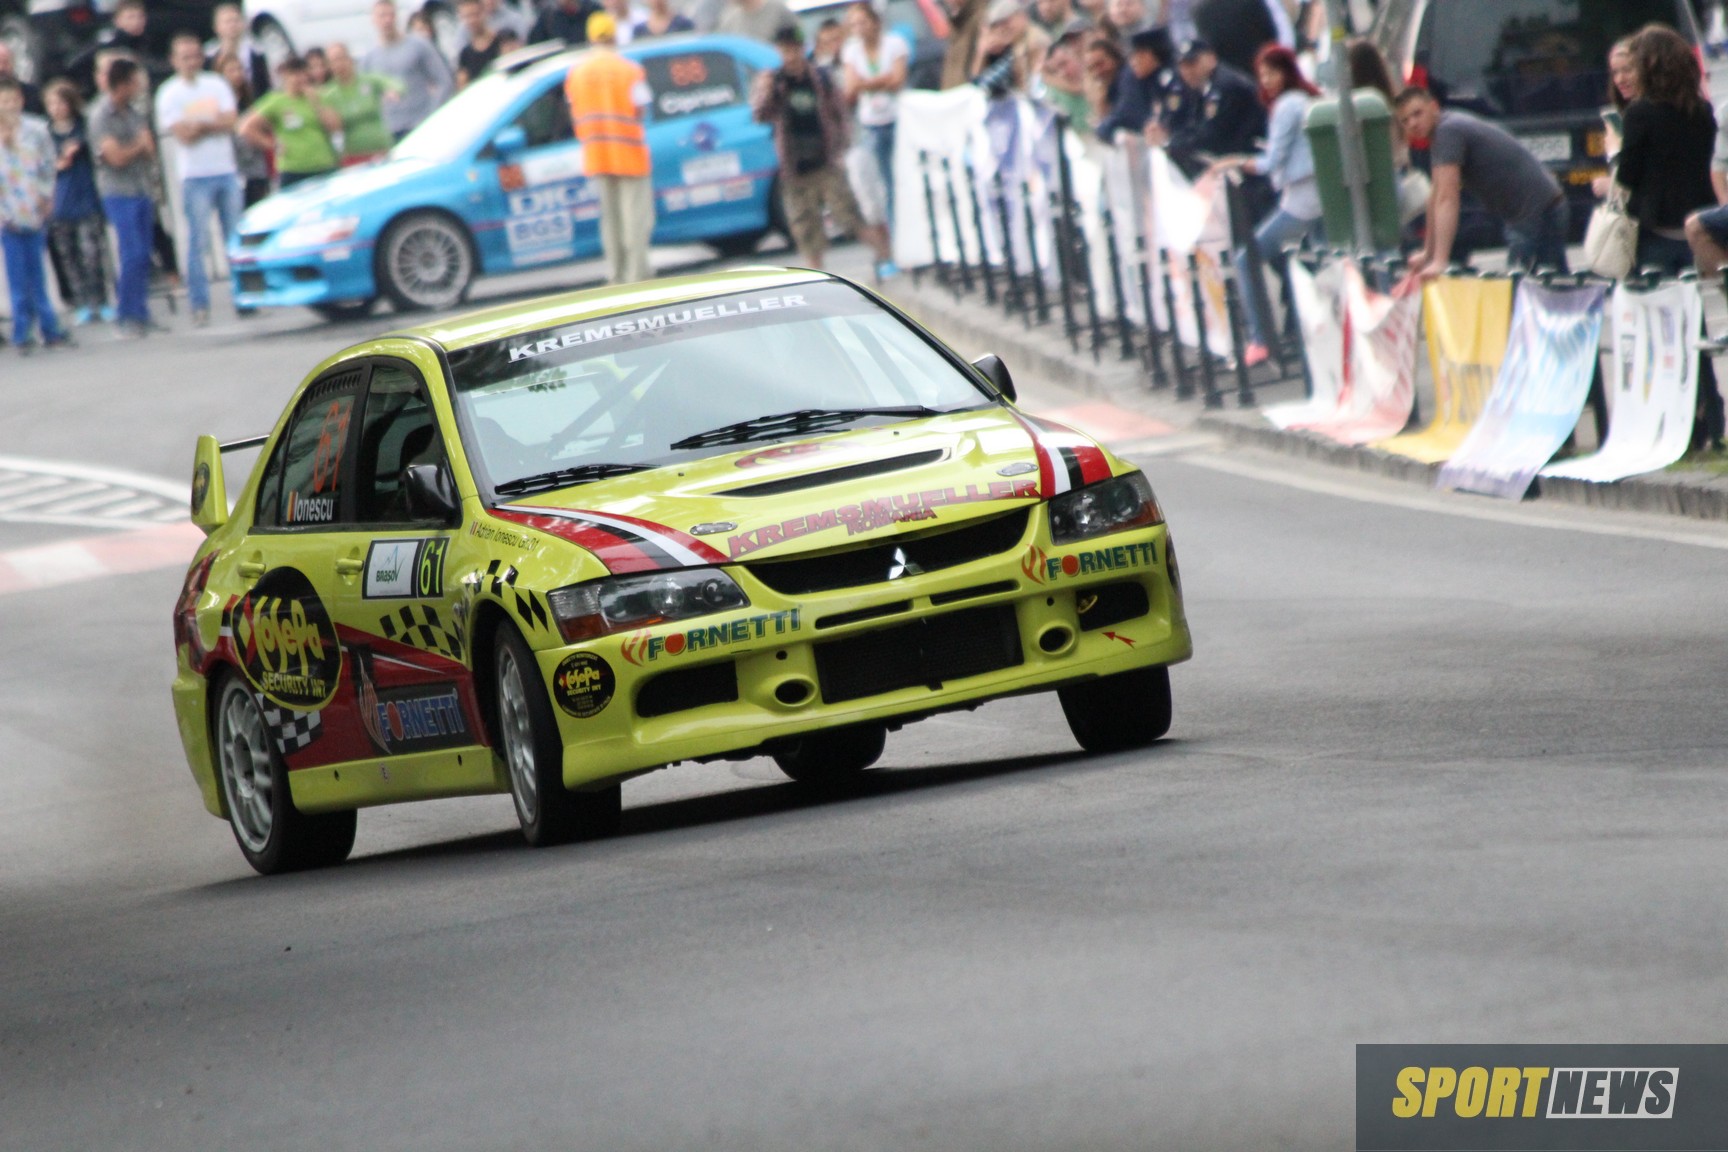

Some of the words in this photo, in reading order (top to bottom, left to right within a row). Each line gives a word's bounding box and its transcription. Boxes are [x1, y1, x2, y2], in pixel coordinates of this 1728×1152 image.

[508, 294, 809, 363] KREMSMUELLER
[314, 400, 350, 494] 61
[293, 492, 334, 522] Ionescu
[727, 480, 1042, 560] KREMSMUELLER
[847, 508, 938, 537] ROMANIA
[420, 540, 446, 596] 61
[1046, 540, 1159, 581] FORNETTI
[648, 607, 801, 662] FORNETTI
[261, 671, 310, 696] SECURITY
